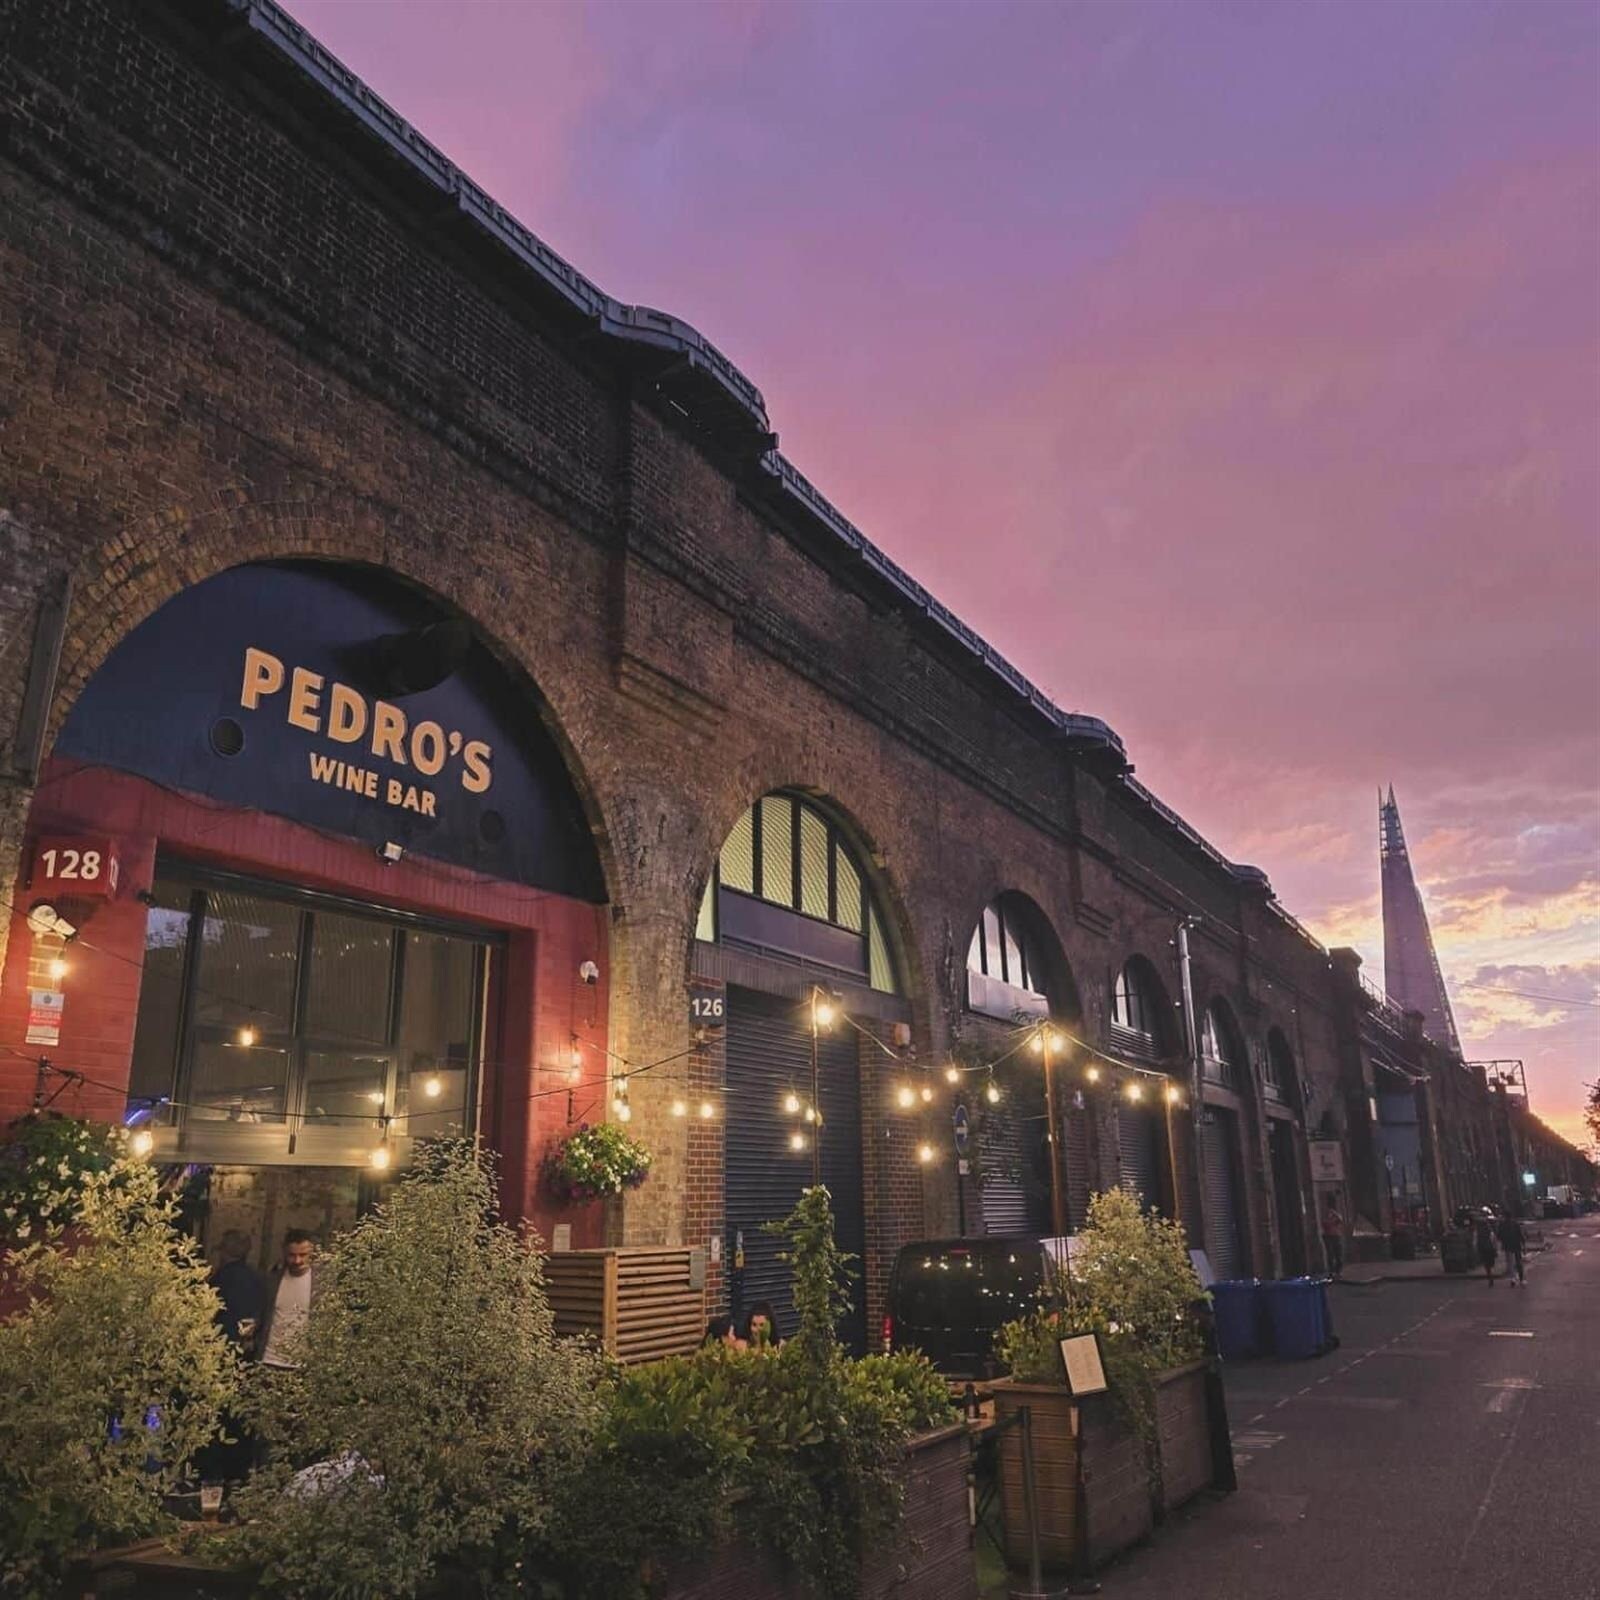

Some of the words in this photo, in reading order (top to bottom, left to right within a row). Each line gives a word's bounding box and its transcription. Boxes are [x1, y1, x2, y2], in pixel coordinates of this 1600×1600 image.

[241, 647, 493, 793] PEDRO'S
[310, 752, 379, 799] WINE
[387, 779, 436, 817] BAR
[42, 849, 101, 880] 128
[692, 998, 723, 1017] 126
